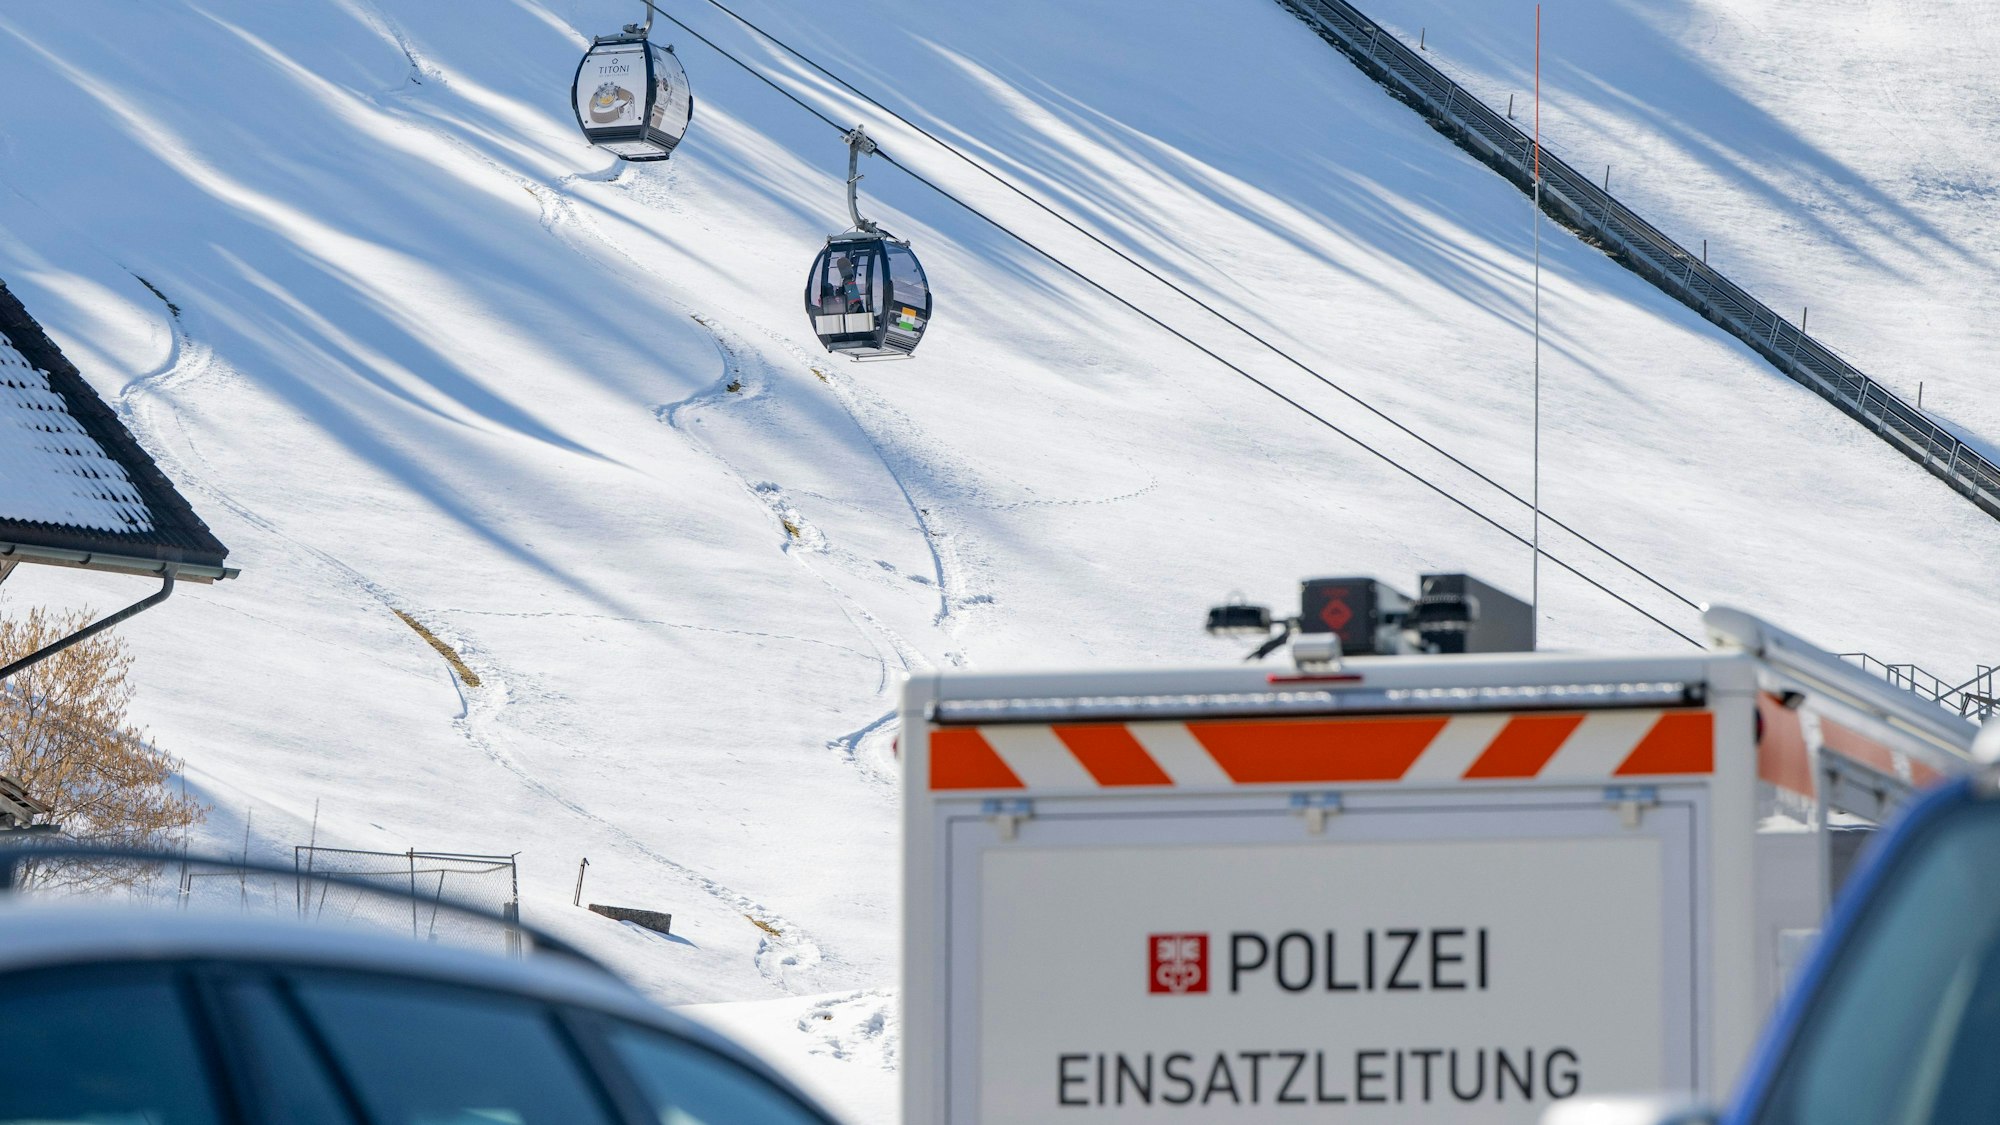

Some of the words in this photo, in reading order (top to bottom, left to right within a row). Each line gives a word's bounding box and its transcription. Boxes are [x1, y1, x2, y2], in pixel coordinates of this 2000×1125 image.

[599, 65, 630, 74] TITONI
[1230, 928, 1488, 994] POLIZEI
[1057, 1046, 1580, 1106] EINSATZLEITUNG
